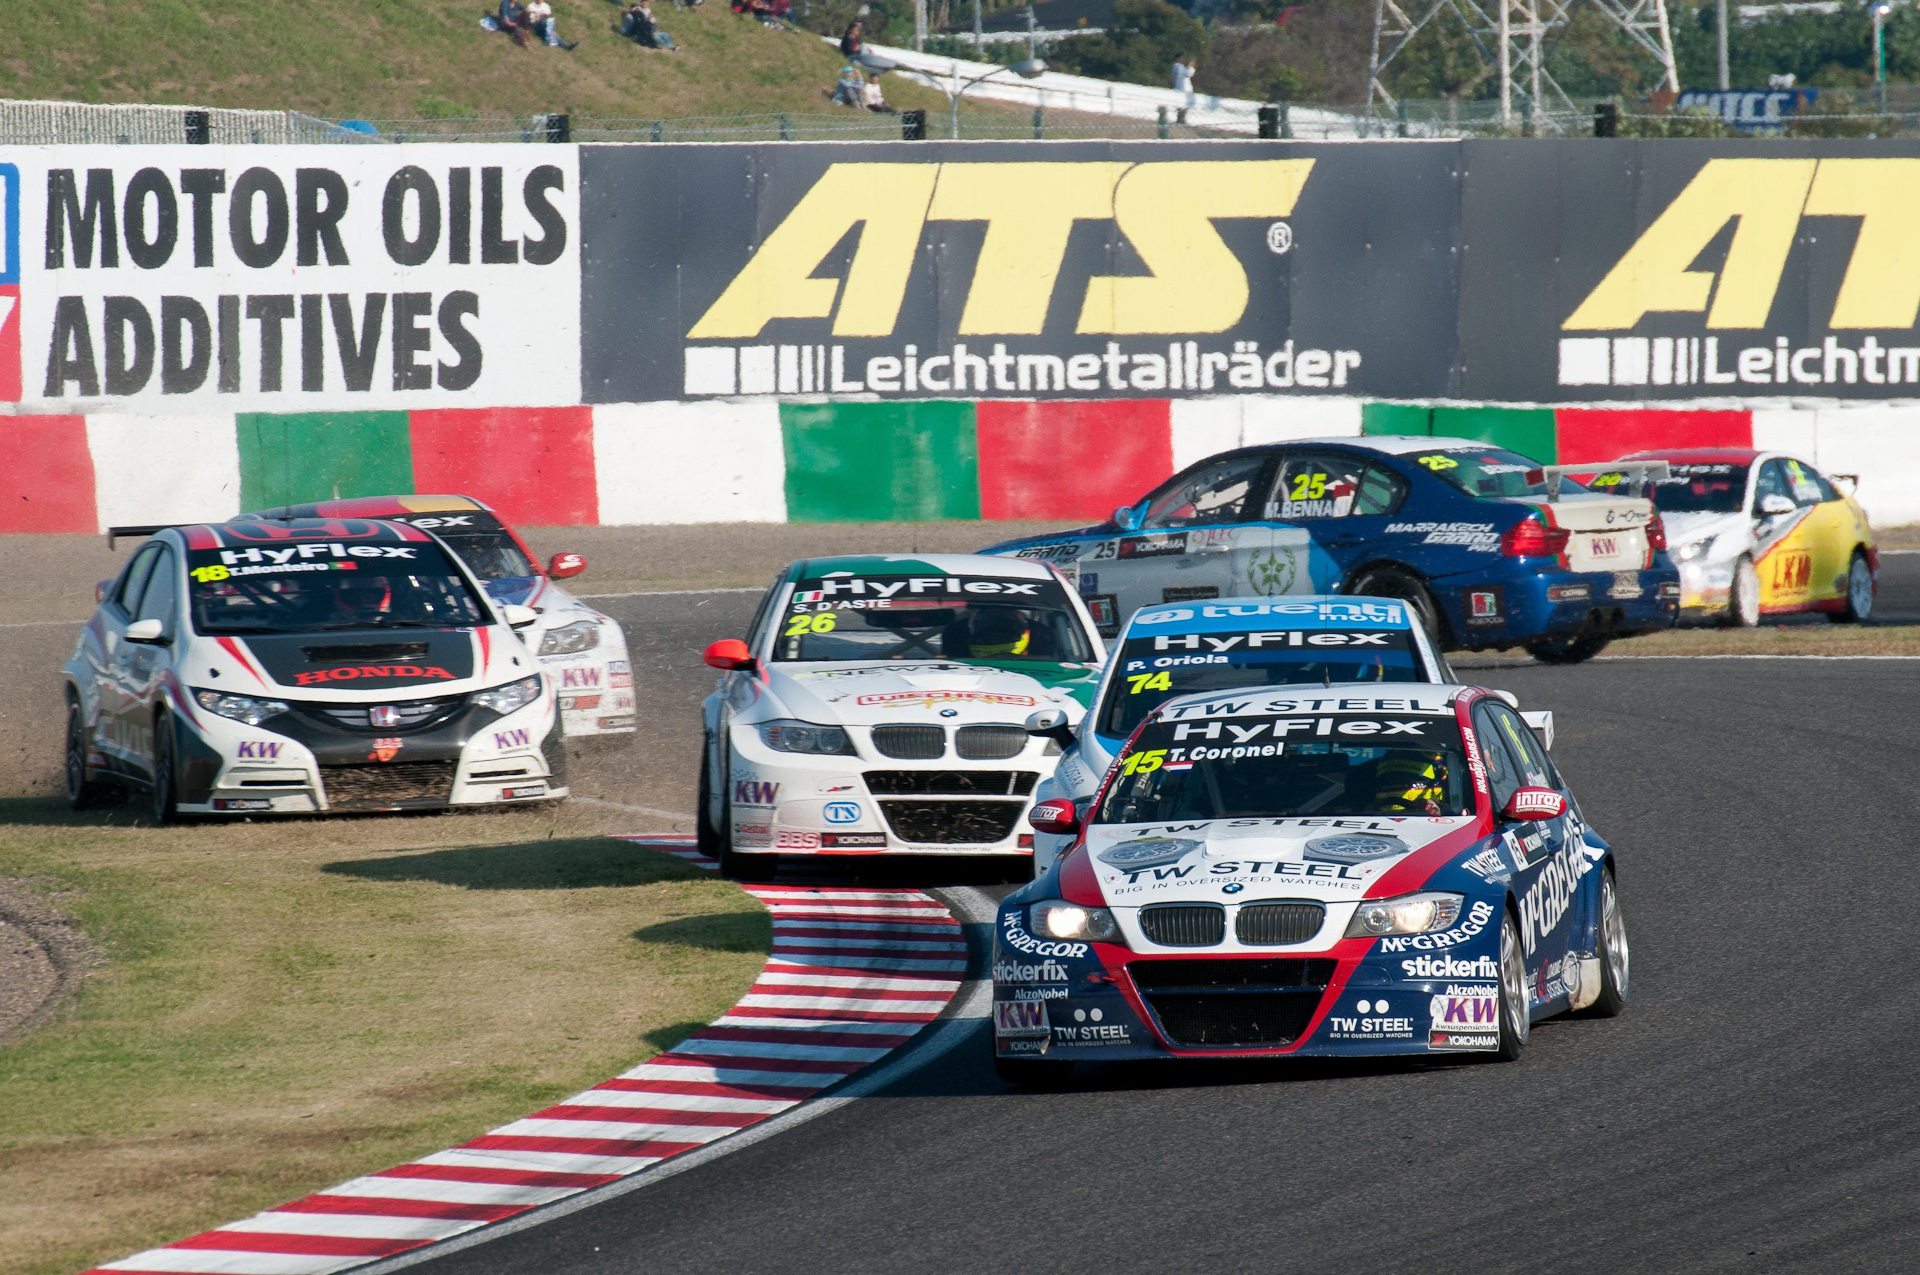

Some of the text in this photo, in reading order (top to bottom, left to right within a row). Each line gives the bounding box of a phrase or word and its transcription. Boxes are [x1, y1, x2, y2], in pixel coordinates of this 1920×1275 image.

[45, 166, 350, 269] MOTOR
[381, 164, 567, 265] OILS
[685, 157, 1316, 337] ATS
[42, 290, 483, 397] ADDITIVES
[831, 339, 1362, 393] Leichtmetallräder
[1290, 473, 1327, 501] 25
[1385, 522, 1495, 534] MARRAKECH
[1422, 531, 1501, 544] GRAND
[219, 543, 417, 565] HyFlex
[1094, 541, 1116, 559] 25
[1591, 538, 1616, 556] KW
[558, 554, 583, 569] 16
[190, 564, 231, 583] 18
[820, 577, 1042, 597] HyFlex
[792, 602, 814, 614] S.
[1202, 602, 1402, 618] tuenti
[785, 612, 837, 636] 26
[1154, 631, 1389, 652] HyFlex
[1127, 654, 1229, 672] P. Oriola
[293, 665, 457, 686] HONDA
[562, 667, 603, 687] KW
[1127, 671, 1173, 695] 74
[1170, 698, 1450, 718] TW STEEL
[494, 728, 530, 749] KW
[1173, 717, 1426, 744] HyFlex
[237, 741, 284, 758] KW
[1122, 742, 1285, 776] 15 T. Coronel
[735, 780, 780, 804] KW
[1131, 818, 1396, 837] TW STEEL
[776, 831, 820, 849] BBS
[835, 835, 885, 846] YOKOHAMA
[1122, 861, 1366, 885] TW STEEL
[1114, 876, 1362, 896] BIG IN OVERSIZED WATCHES
[1004, 909, 1089, 959] McGREGOR
[1380, 900, 1495, 953] McGREGOR
[993, 959, 1068, 982] stickerfix
[1401, 955, 1498, 978] stickerfix
[1014, 988, 1069, 1000] AkzoNobel
[1445, 984, 1498, 997] AkzoNobel
[1000, 1002, 1045, 1028] KW
[1444, 998, 1498, 1023] KW
[1054, 1025, 1130, 1039] TW STEEL
[1331, 1018, 1414, 1031] TW STEEL
[1435, 1022, 1498, 1031] kwsuspensions.de
[1448, 1034, 1498, 1046] YOKOHAMA
